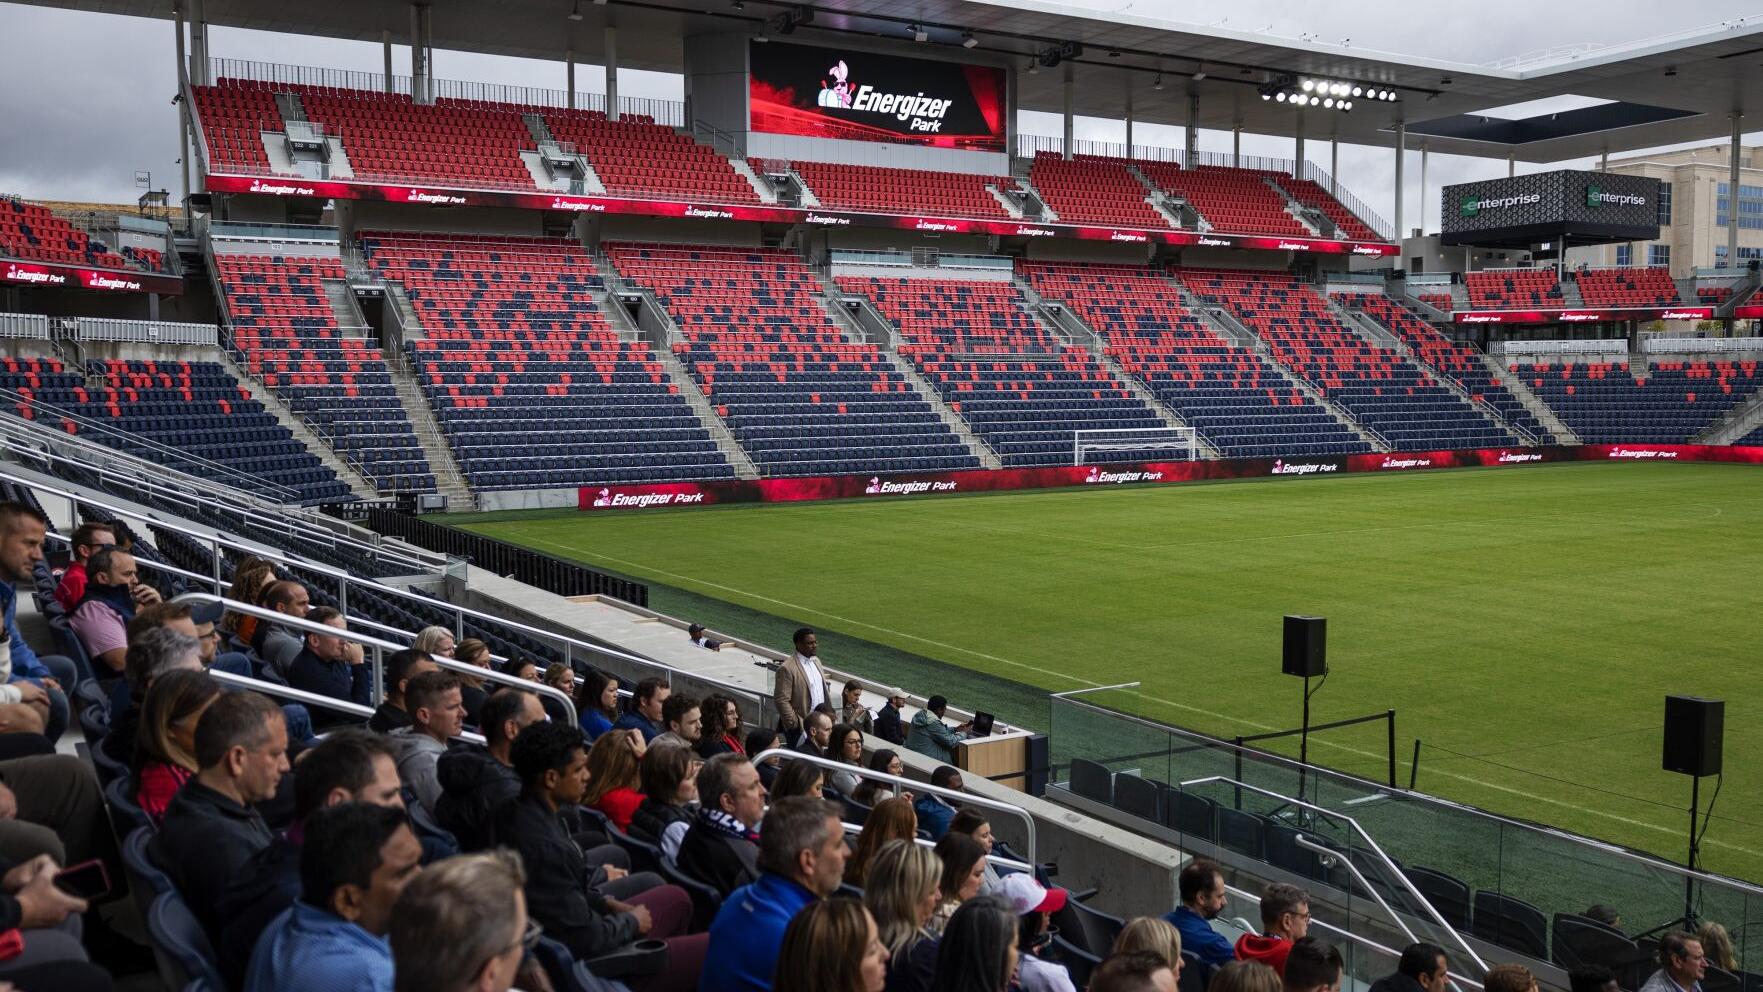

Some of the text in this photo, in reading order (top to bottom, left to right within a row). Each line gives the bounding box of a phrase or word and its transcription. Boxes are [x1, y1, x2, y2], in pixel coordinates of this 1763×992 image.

[852, 85, 952, 121] Energizer
[910, 117, 942, 133] Park
[260, 184, 297, 195] Energizer
[418, 193, 466, 204] Energizer Park
[1463, 192, 1541, 211] enterprise
[1589, 190, 1646, 206] enterprise
[560, 201, 591, 211] Energizer
[693, 209, 720, 219] Energizer
[813, 215, 838, 225] Energizer
[922, 222, 945, 231] Energizer
[1022, 228, 1044, 236] Energizer
[1116, 233, 1136, 241] Energizer
[1203, 238, 1222, 246] Energizer
[17, 270, 65, 284] Energizer Park
[98, 277, 141, 290] Energizer Park
[1506, 453, 1531, 463] Energizer
[1620, 449, 1678, 459] Energizer Park
[1390, 458, 1417, 468] Energizer
[1282, 463, 1338, 475] Energizer Park
[1099, 471, 1163, 484] Energizer Park
[880, 480, 957, 495] Energizer Park
[610, 492, 704, 507] Energizer Park
